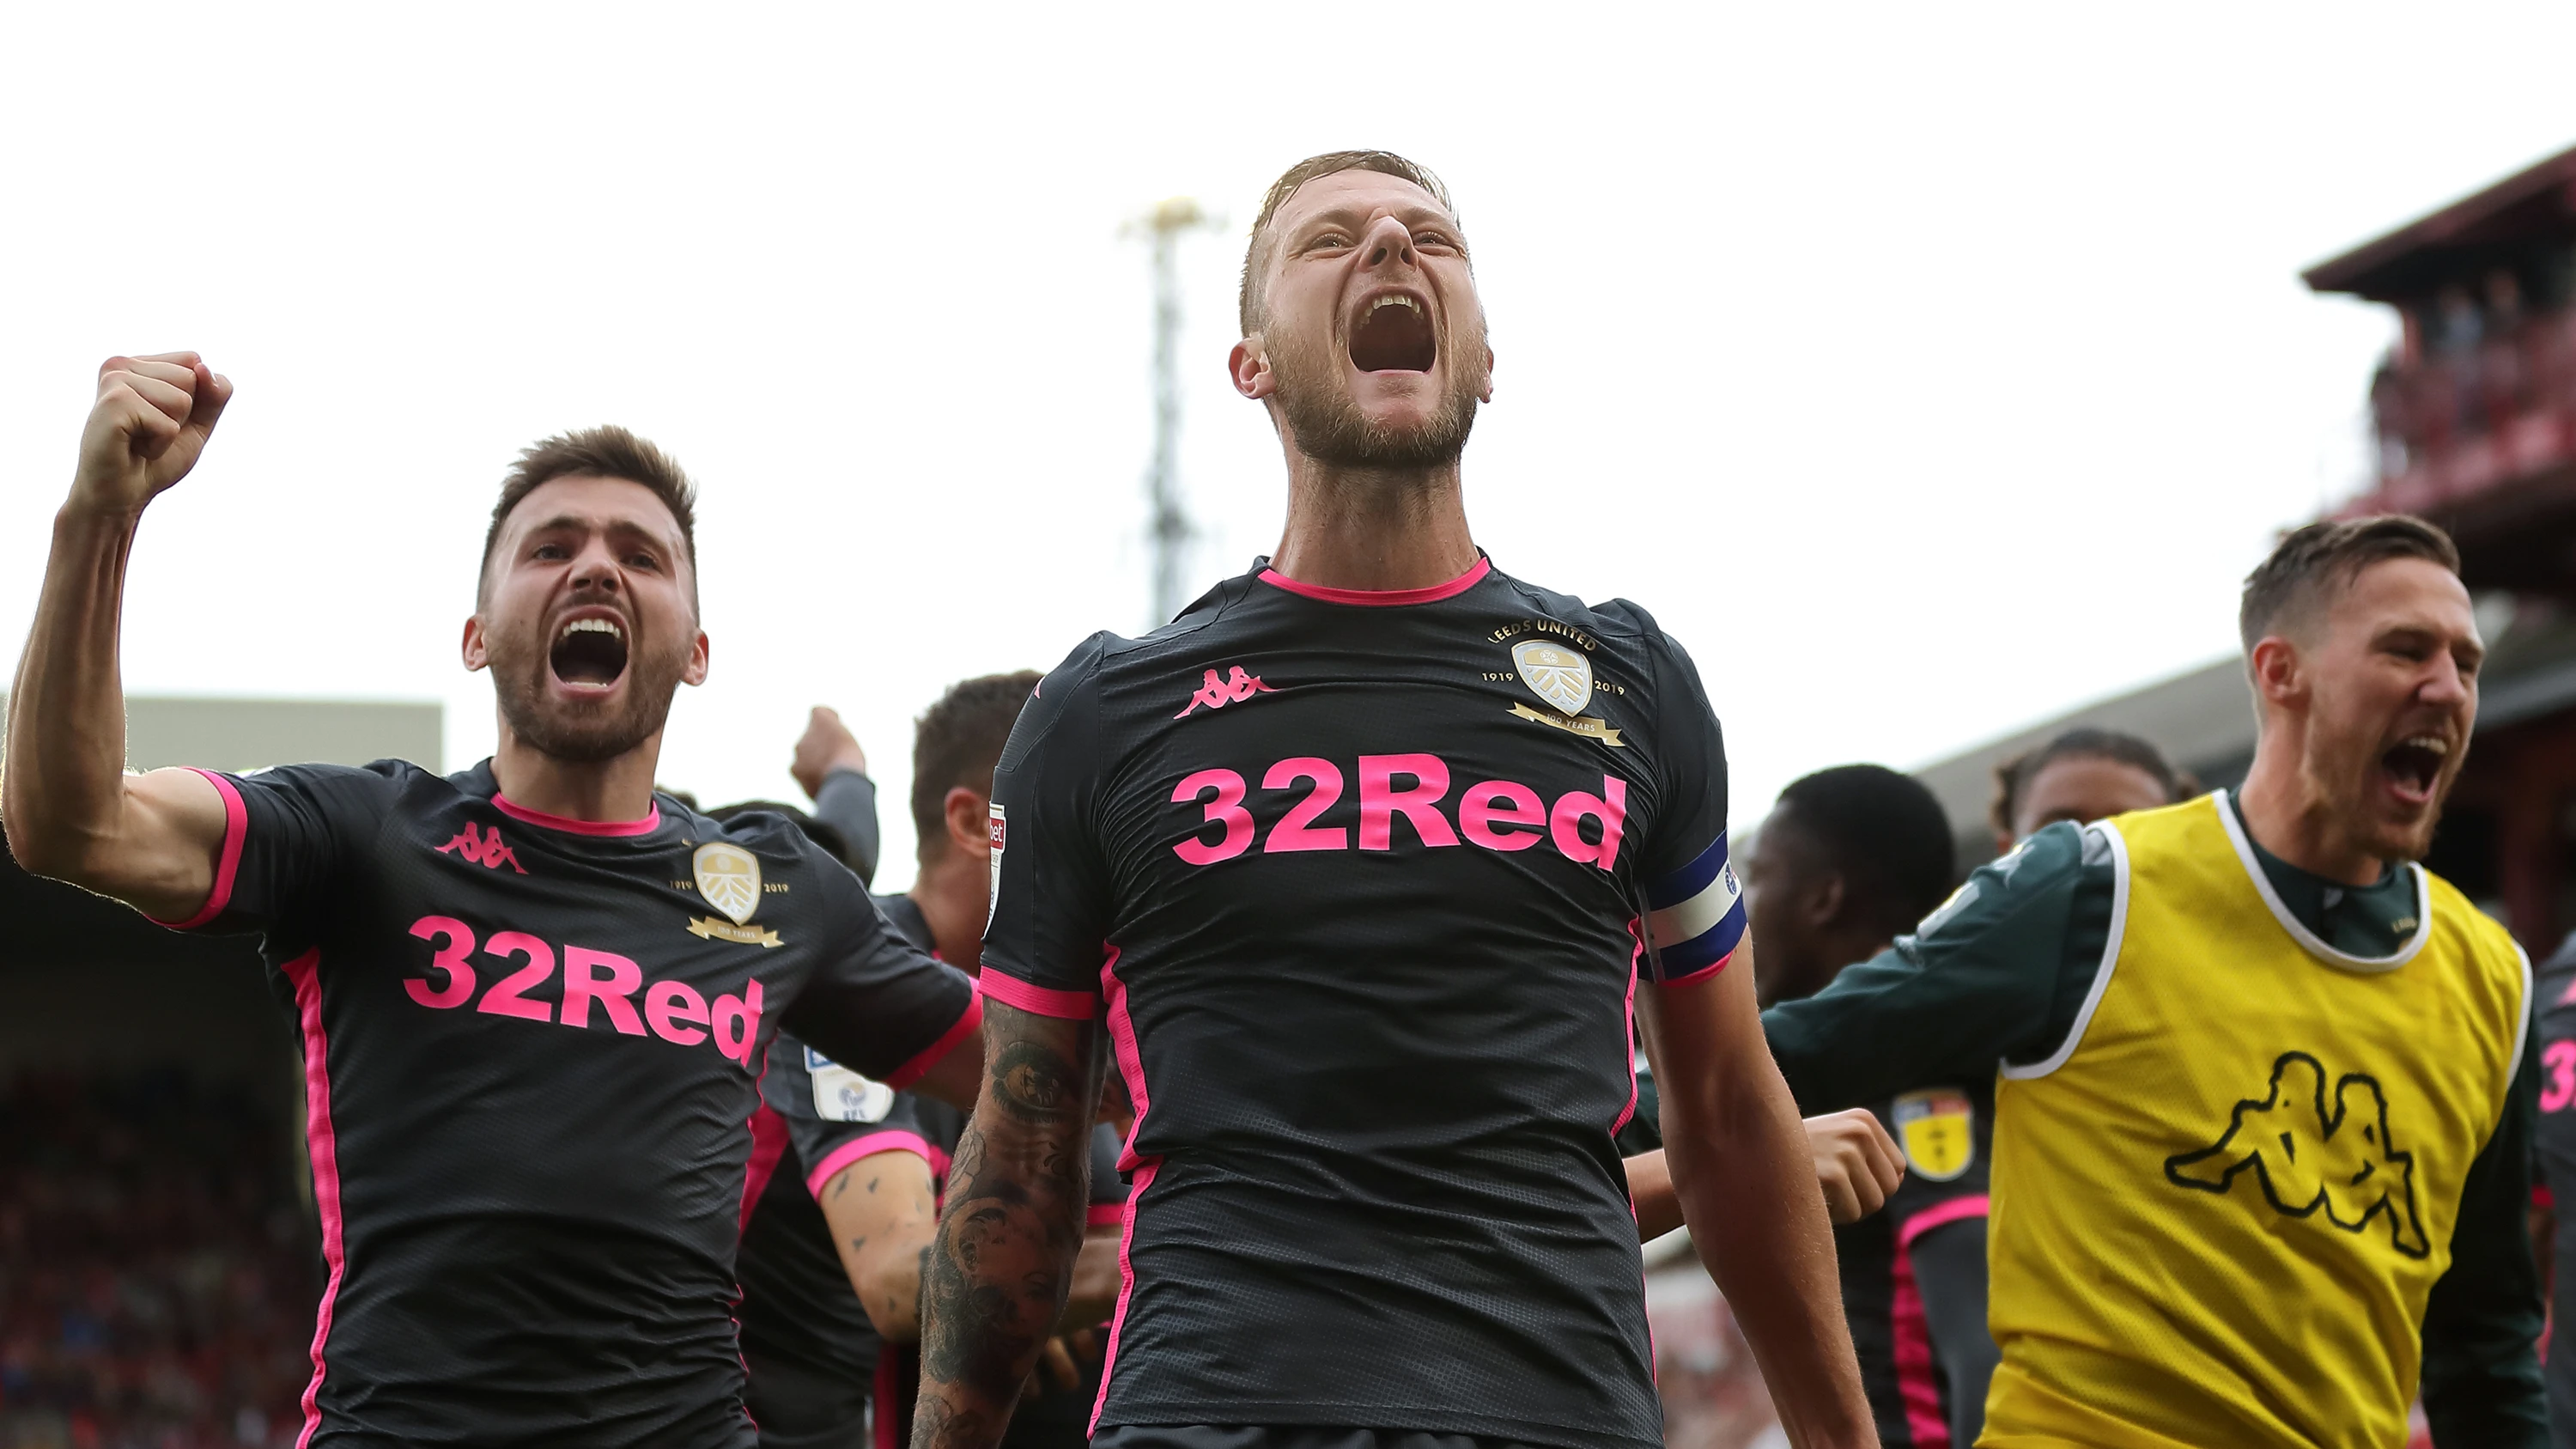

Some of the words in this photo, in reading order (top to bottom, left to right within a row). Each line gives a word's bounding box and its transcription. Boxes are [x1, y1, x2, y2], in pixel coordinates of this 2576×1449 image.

[1487, 619, 1532, 644] LEEDS
[1537, 619, 1597, 651] UNITED
[1482, 673, 1514, 682] 1919
[1595, 680, 1625, 696] 2019
[1546, 714, 1562, 724] 100
[1566, 720, 1595, 732] YEARS
[1170, 752, 1626, 872] 32Red
[763, 883, 789, 892] 2019
[403, 915, 762, 1068] 32Red
